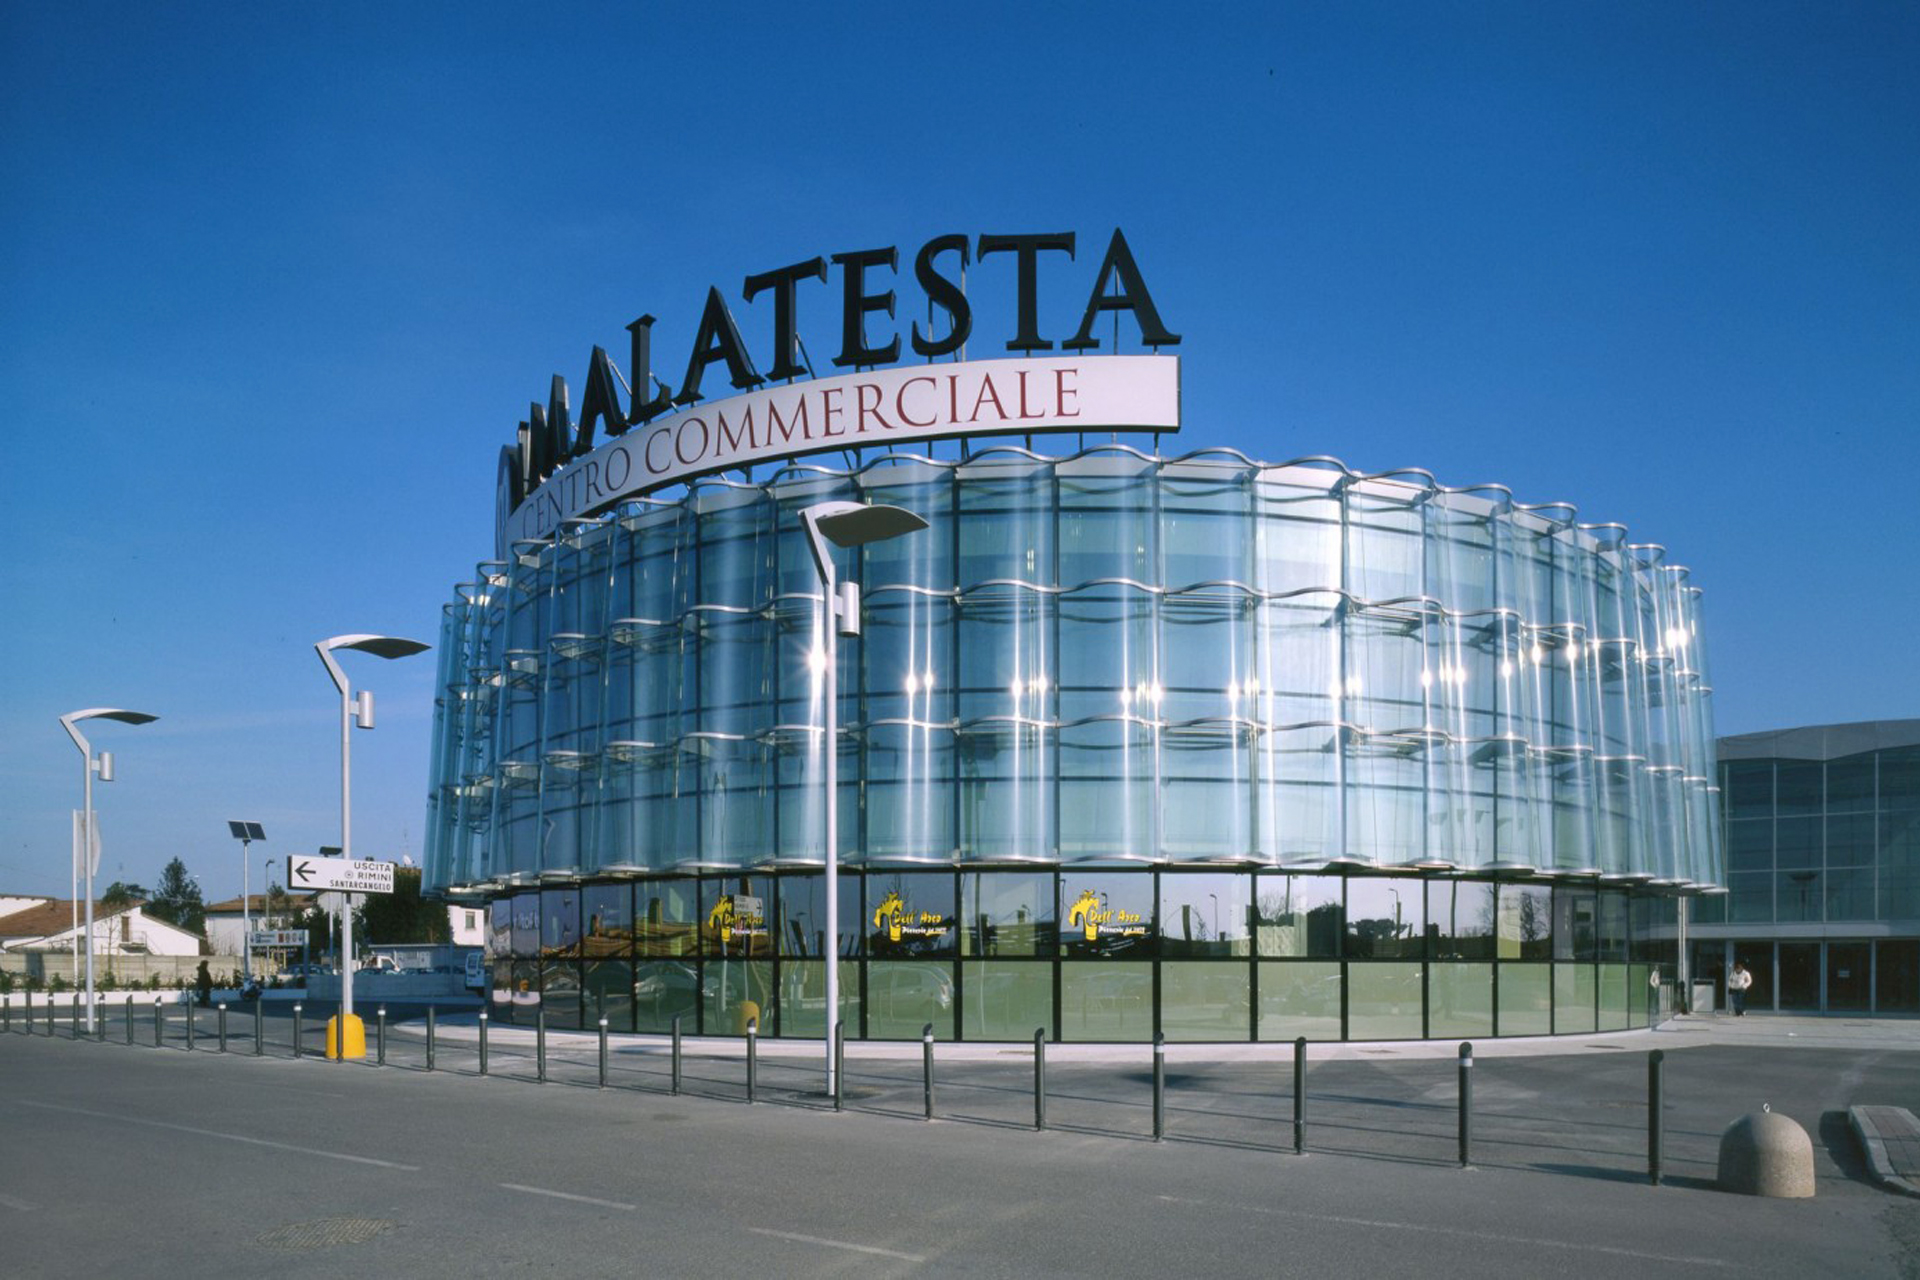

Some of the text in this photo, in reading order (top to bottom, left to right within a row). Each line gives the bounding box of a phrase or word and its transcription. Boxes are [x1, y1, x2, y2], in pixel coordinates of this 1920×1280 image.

[522, 367, 1082, 538] CENTRO COMMERCIALE
[354, 862, 391, 872] USCITA
[357, 871, 392, 882] RIMINI
[330, 879, 392, 891] SANTARCANGELO
